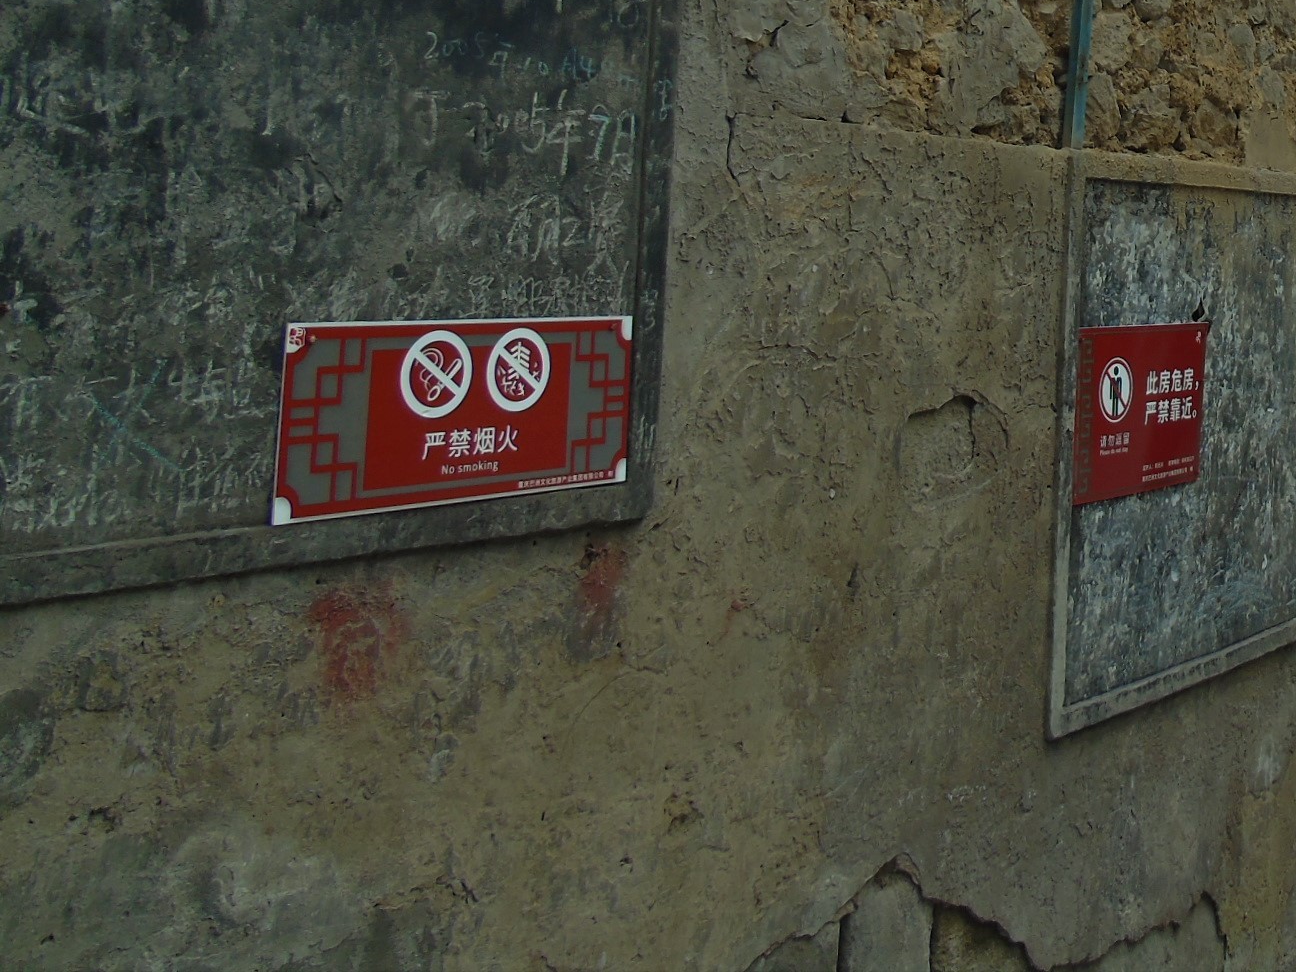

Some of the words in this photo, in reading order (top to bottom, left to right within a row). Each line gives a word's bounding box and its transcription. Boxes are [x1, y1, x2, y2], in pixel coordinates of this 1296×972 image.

[421, 424, 519, 461] 严禁烟火
[441, 464, 455, 475] No
[457, 460, 499, 474] smoking
